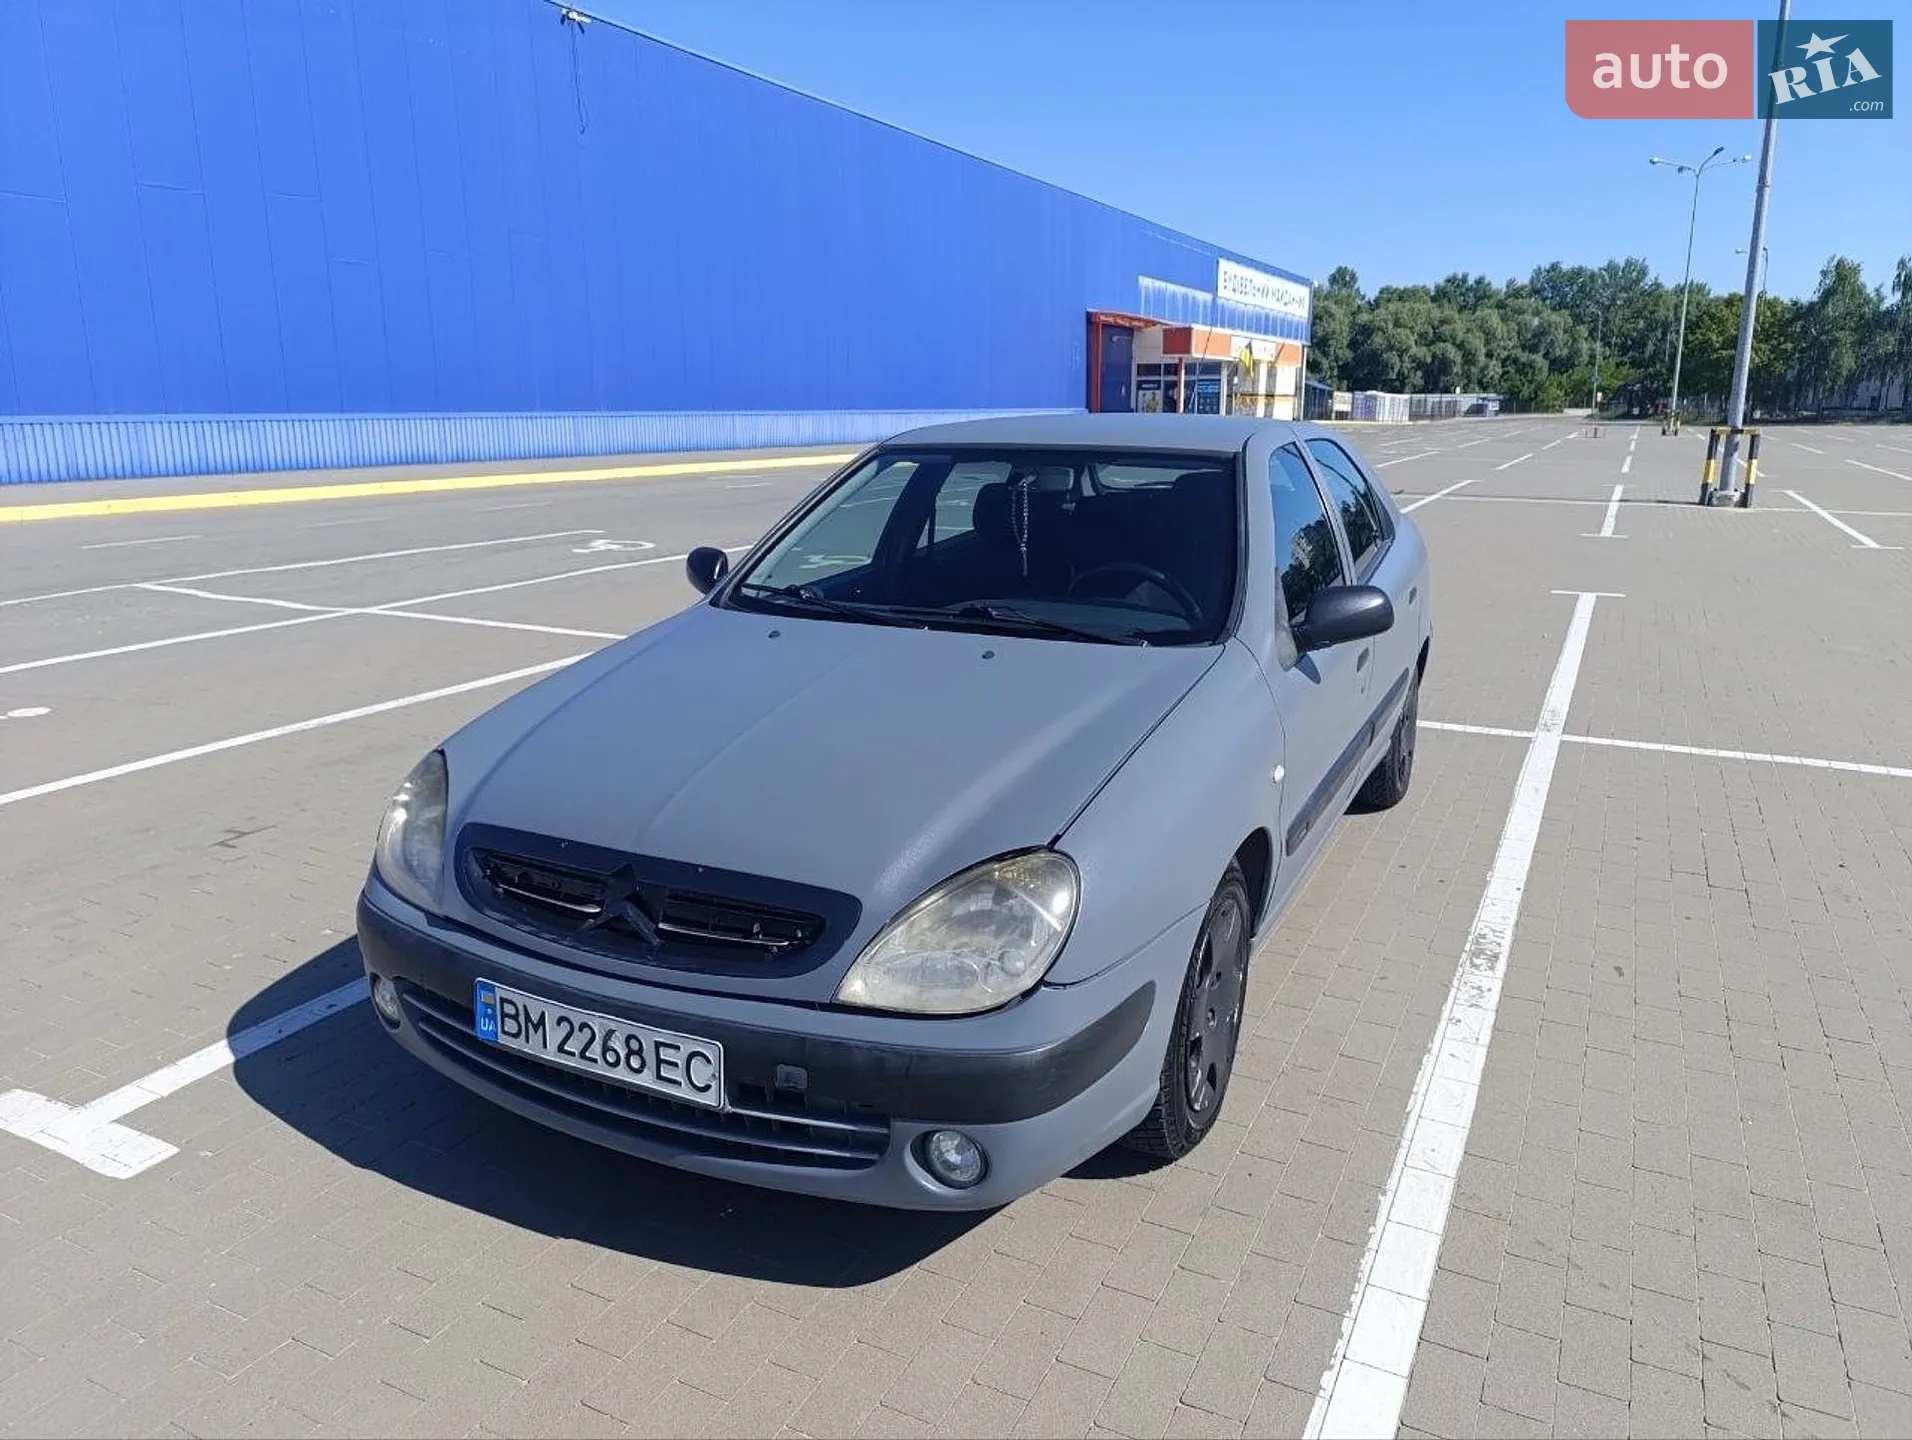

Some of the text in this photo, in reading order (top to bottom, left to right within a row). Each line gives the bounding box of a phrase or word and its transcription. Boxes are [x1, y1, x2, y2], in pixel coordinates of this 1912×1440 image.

[480, 1016, 497, 1035] UA
[499, 996, 718, 1093] BM 2268 EC
